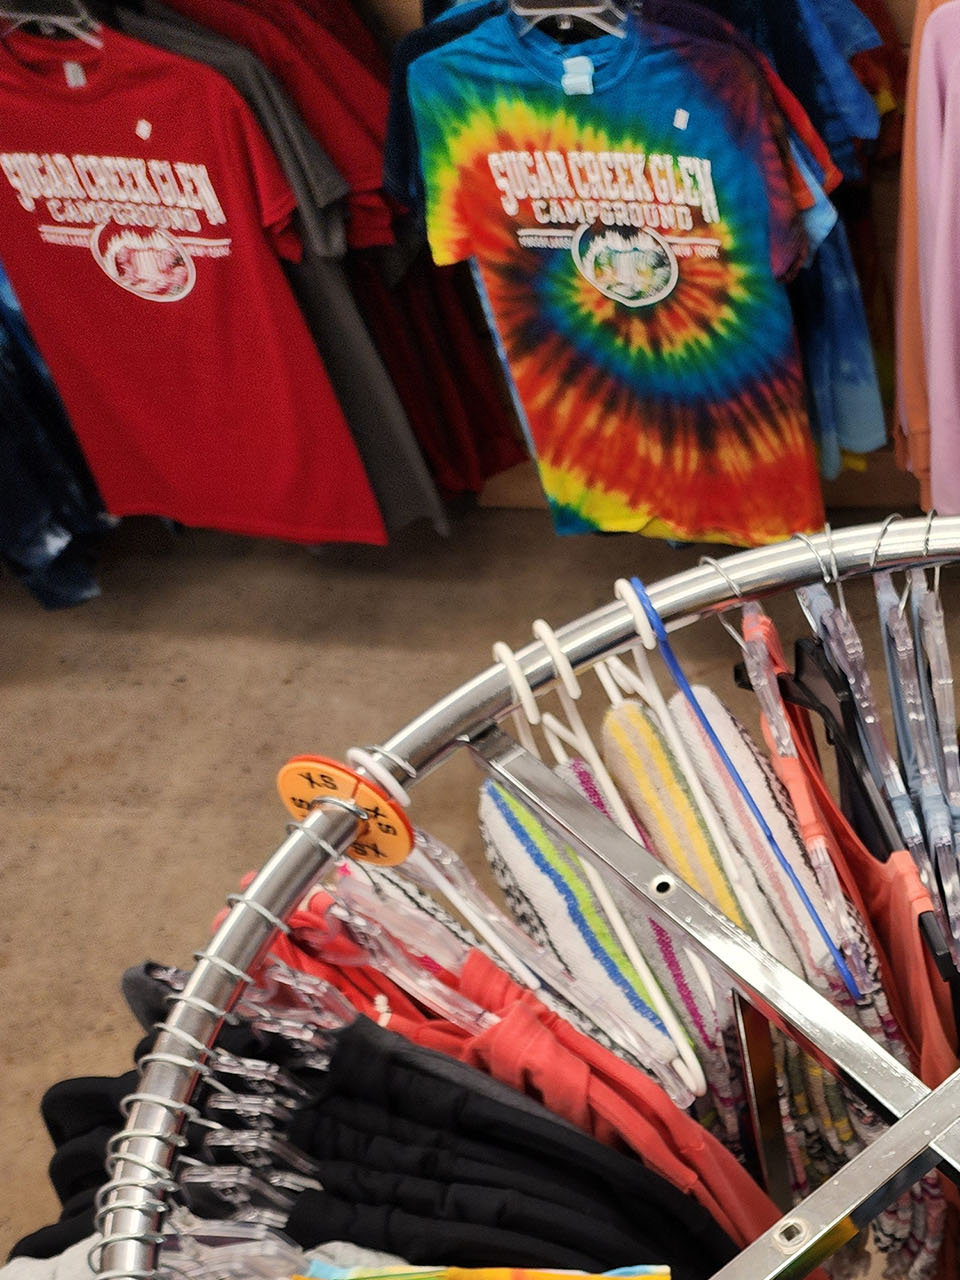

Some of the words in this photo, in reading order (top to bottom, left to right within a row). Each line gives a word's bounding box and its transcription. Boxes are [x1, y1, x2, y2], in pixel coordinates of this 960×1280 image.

[0, 152, 88, 213] SUGAR
[71, 154, 162, 205] CREEK
[147, 158, 228, 226] GLEN
[487, 150, 576, 217] SUGAR
[567, 151, 656, 202] CREEK
[649, 153, 721, 224] GLEN
[47, 198, 202, 233] CAMPGROUND
[531, 199, 694, 232] CAMPGROUND
[297, 771, 339, 791] XS
[363, 805, 398, 837] XS
